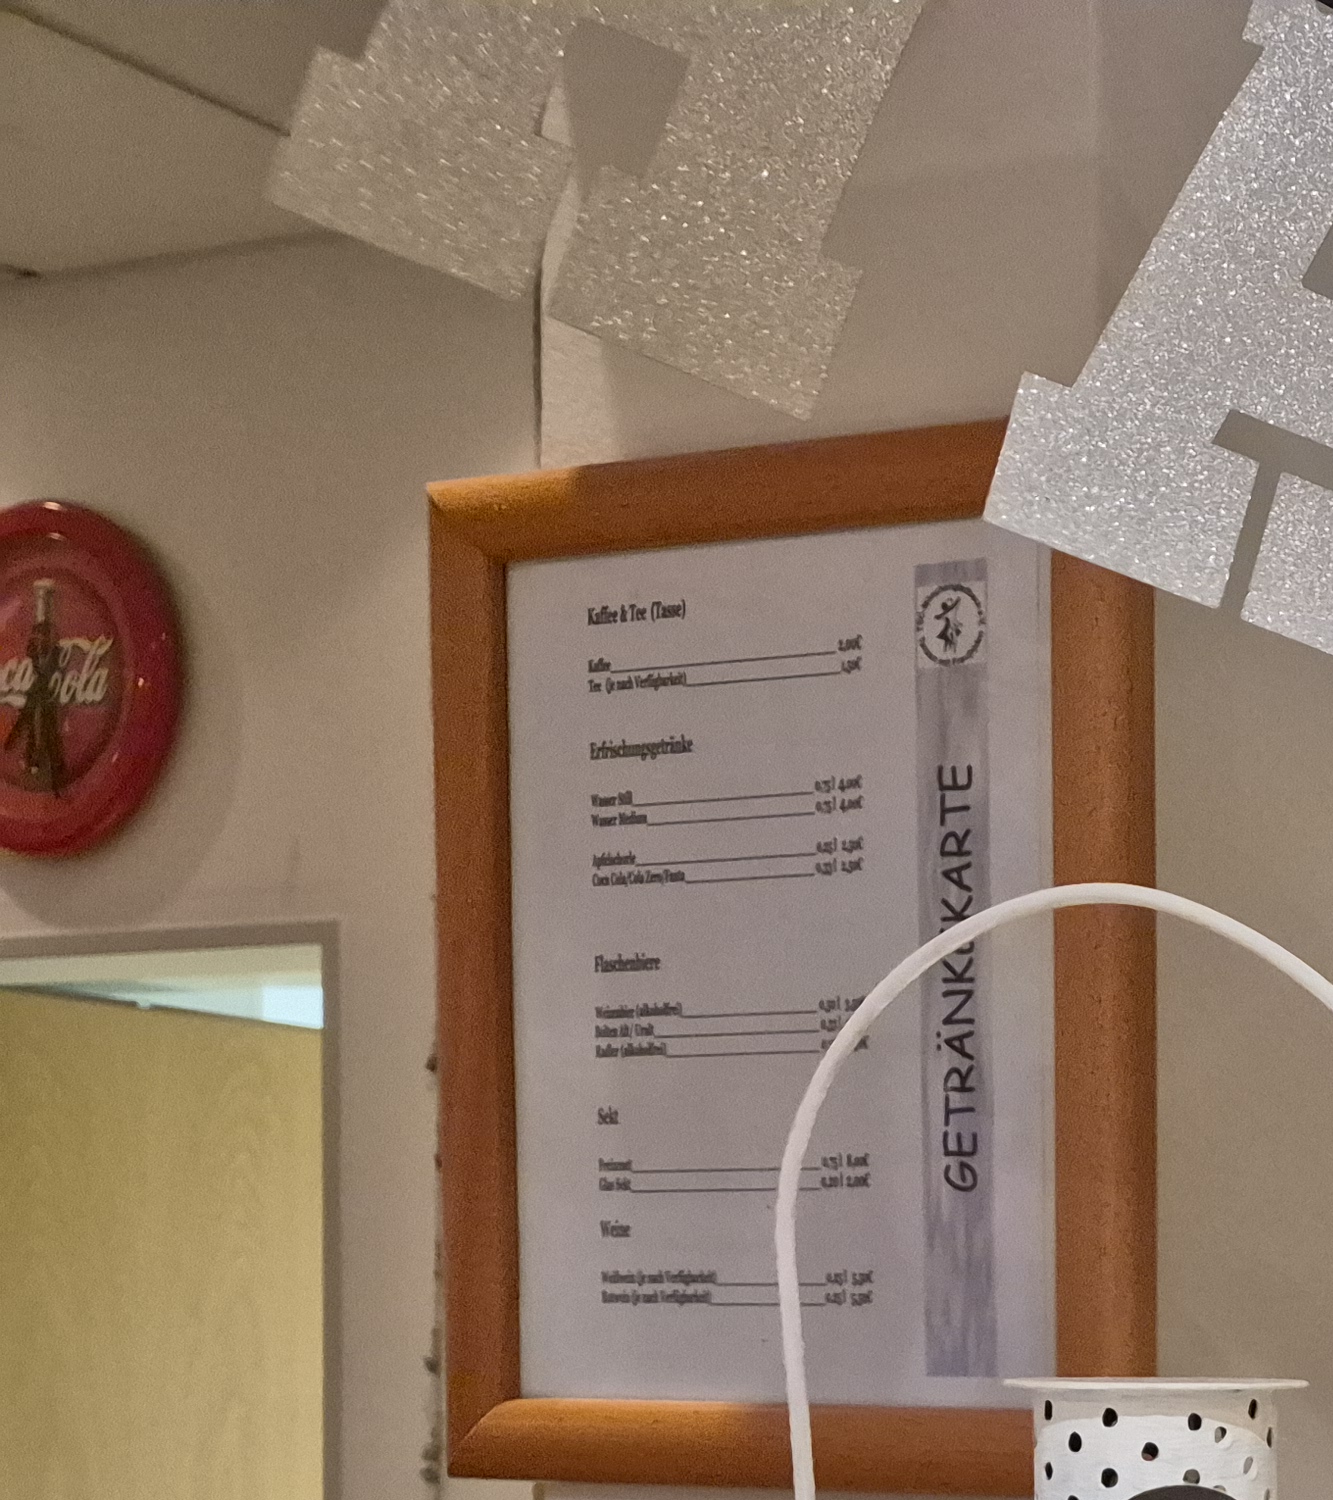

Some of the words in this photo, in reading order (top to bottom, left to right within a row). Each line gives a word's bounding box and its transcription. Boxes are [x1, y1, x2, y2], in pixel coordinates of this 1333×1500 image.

[588, 605, 618, 626] Kaffee
[620, 604, 628, 623] &
[629, 603, 647, 622] Tee
[651, 599, 686, 622] (Tasse)
[588, 679, 602, 693] Tee
[590, 734, 693, 761] Erfrischungsgetränke
[594, 952, 661, 973] Flaschenbiere
[936, 764, 978, 1193] GETRÄNKKARTE
[598, 1105, 620, 1125] Sekt
